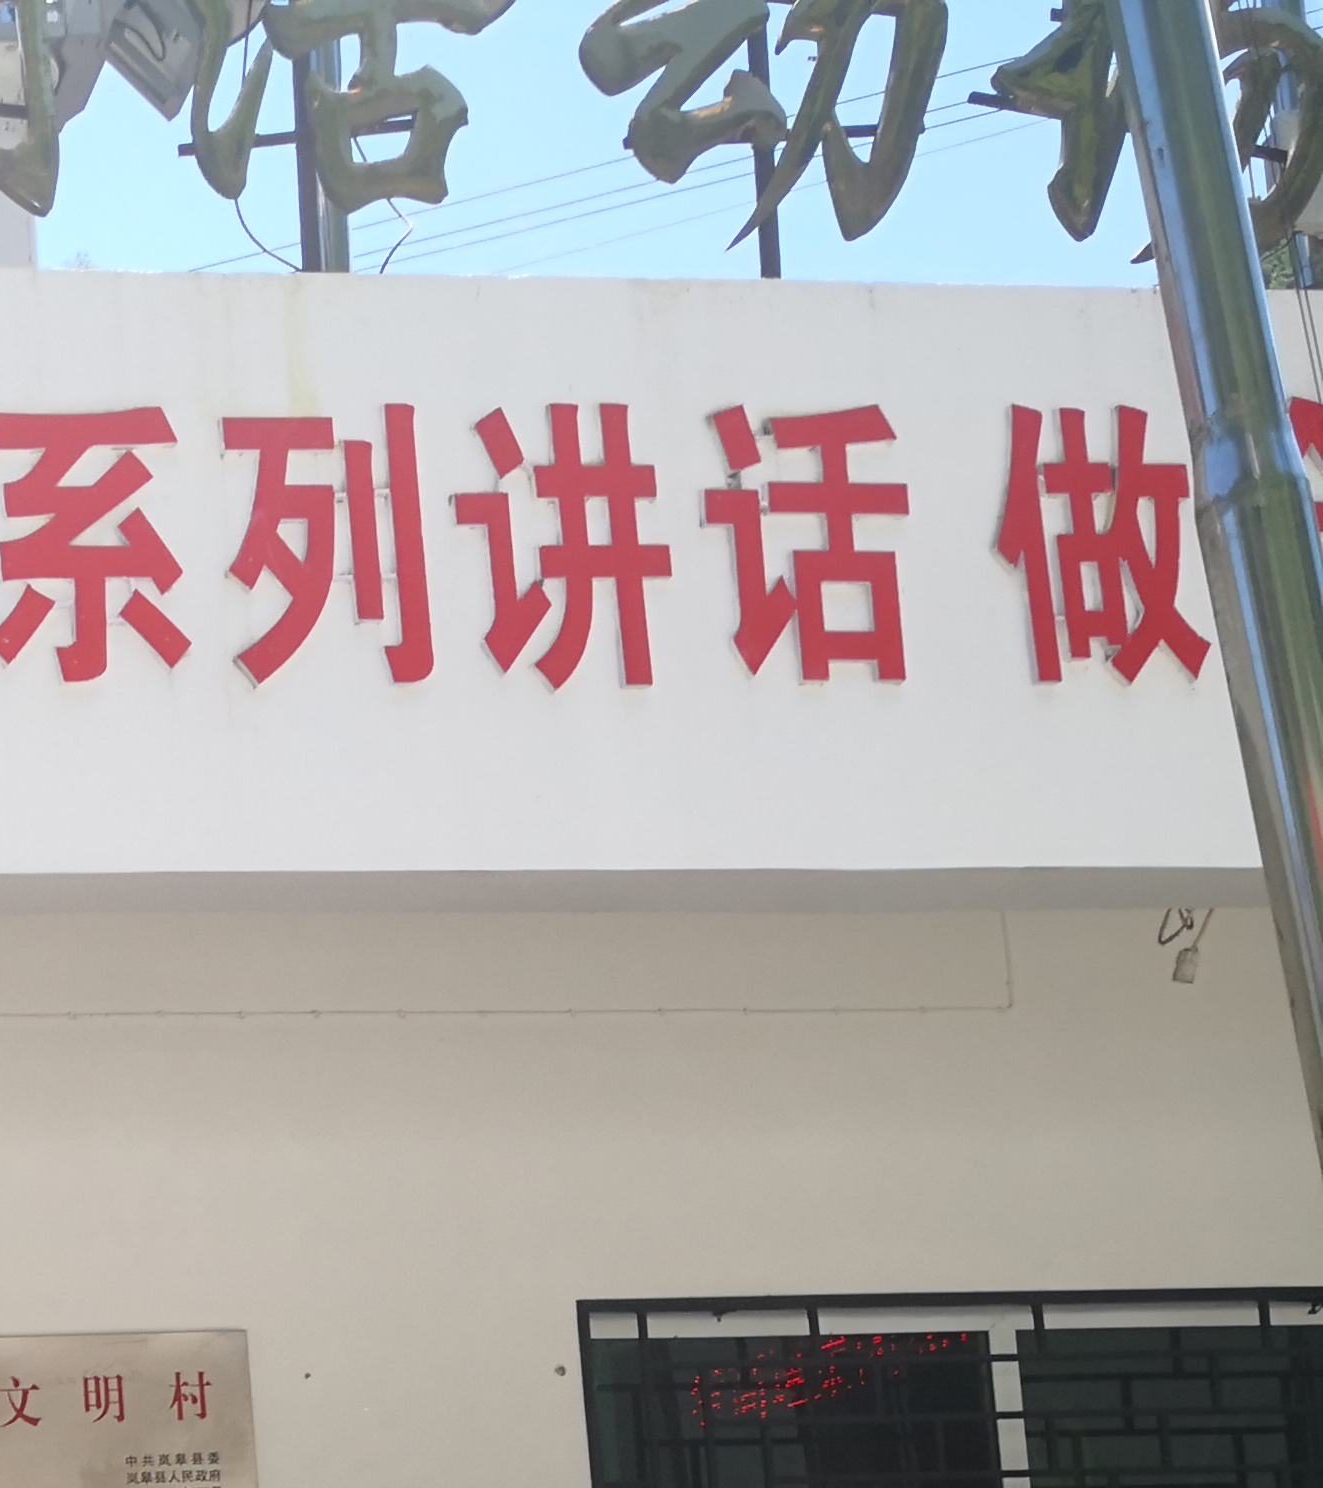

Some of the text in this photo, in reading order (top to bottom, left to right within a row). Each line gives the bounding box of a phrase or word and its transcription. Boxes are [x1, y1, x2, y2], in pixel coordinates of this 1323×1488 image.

[125, 1452, 221, 1467] 中共岚皋县委
[126, 1468, 222, 1484] 岚皋县人民政府
